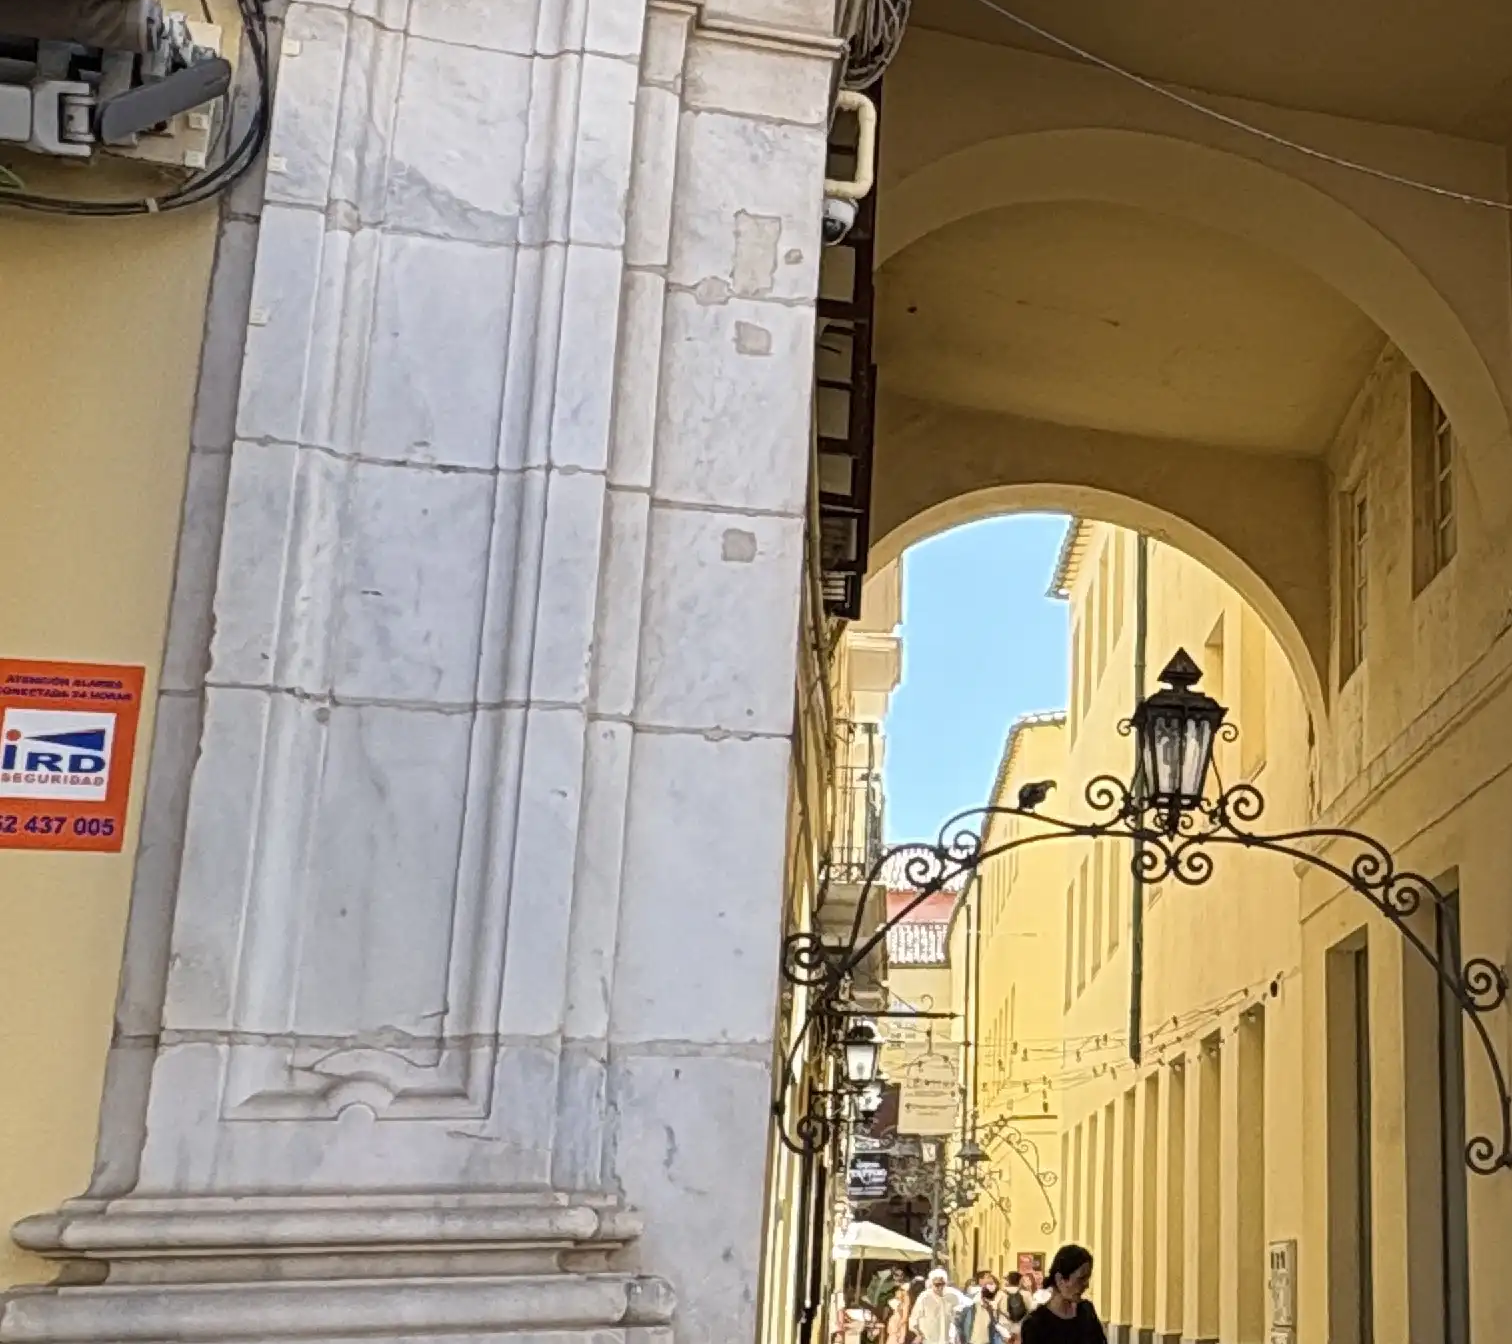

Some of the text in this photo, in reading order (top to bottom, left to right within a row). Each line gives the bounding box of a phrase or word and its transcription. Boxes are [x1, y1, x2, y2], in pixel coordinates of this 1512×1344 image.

[1, 773, 104, 786] SEGURIDAD
[24, 816, 67, 834] 437
[73, 818, 115, 836] 005
